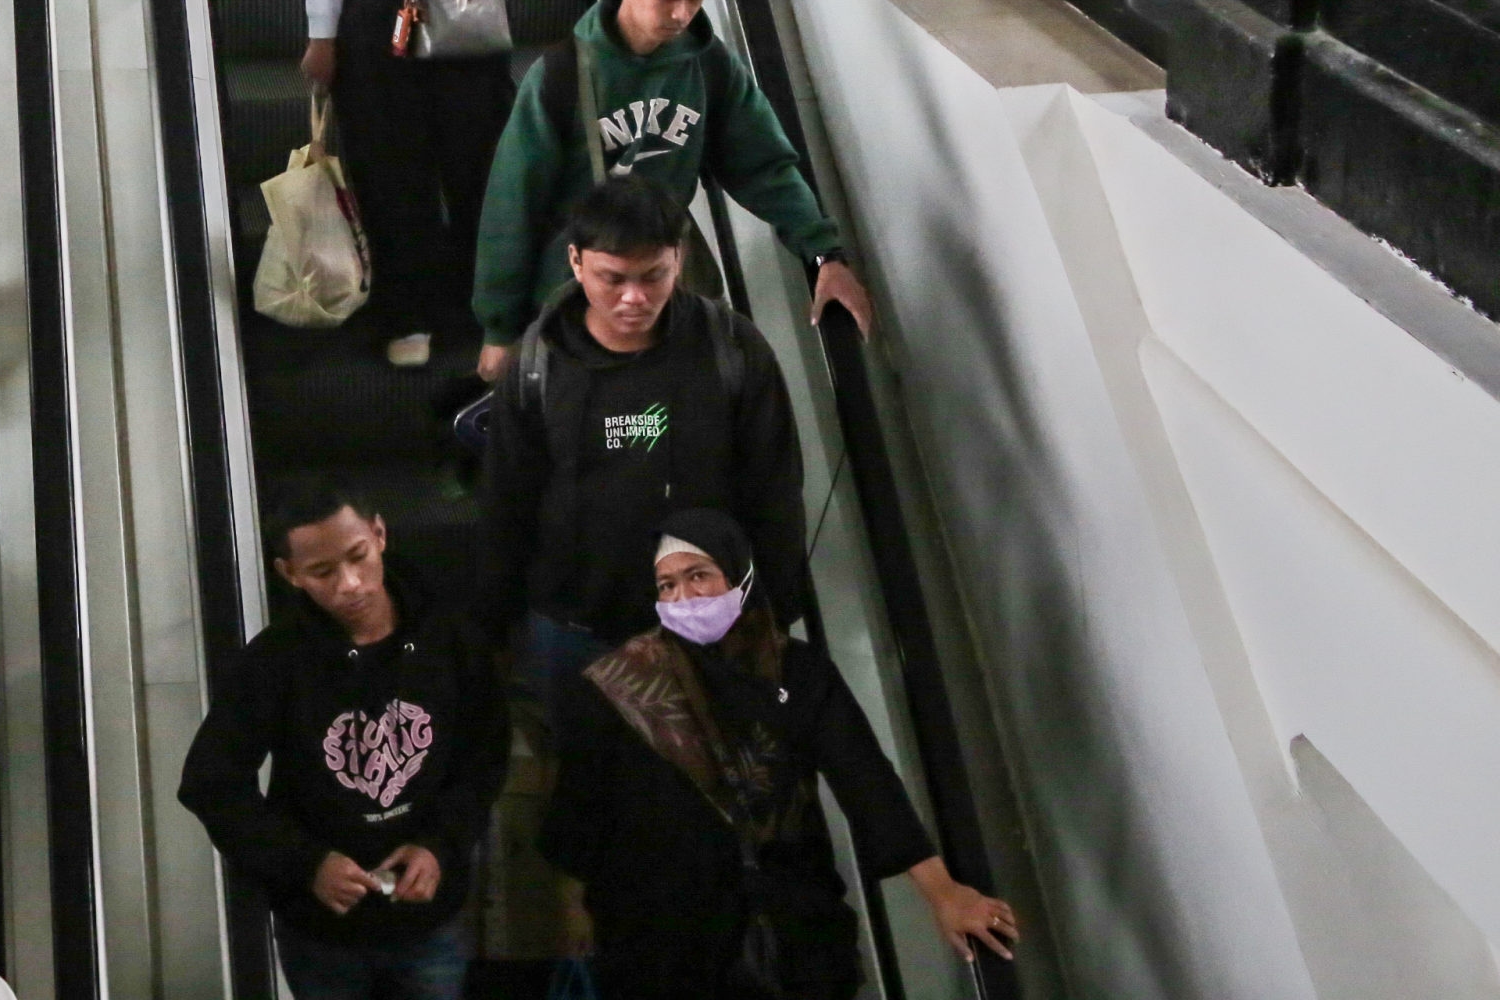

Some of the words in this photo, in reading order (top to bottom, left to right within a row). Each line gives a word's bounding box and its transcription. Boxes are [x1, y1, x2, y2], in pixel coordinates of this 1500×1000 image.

[598, 98, 700, 150] NIKE
[605, 415, 660, 428] BREAKSIDE
[606, 426, 661, 438] UNLIMITED
[606, 439, 623, 449] CO.
